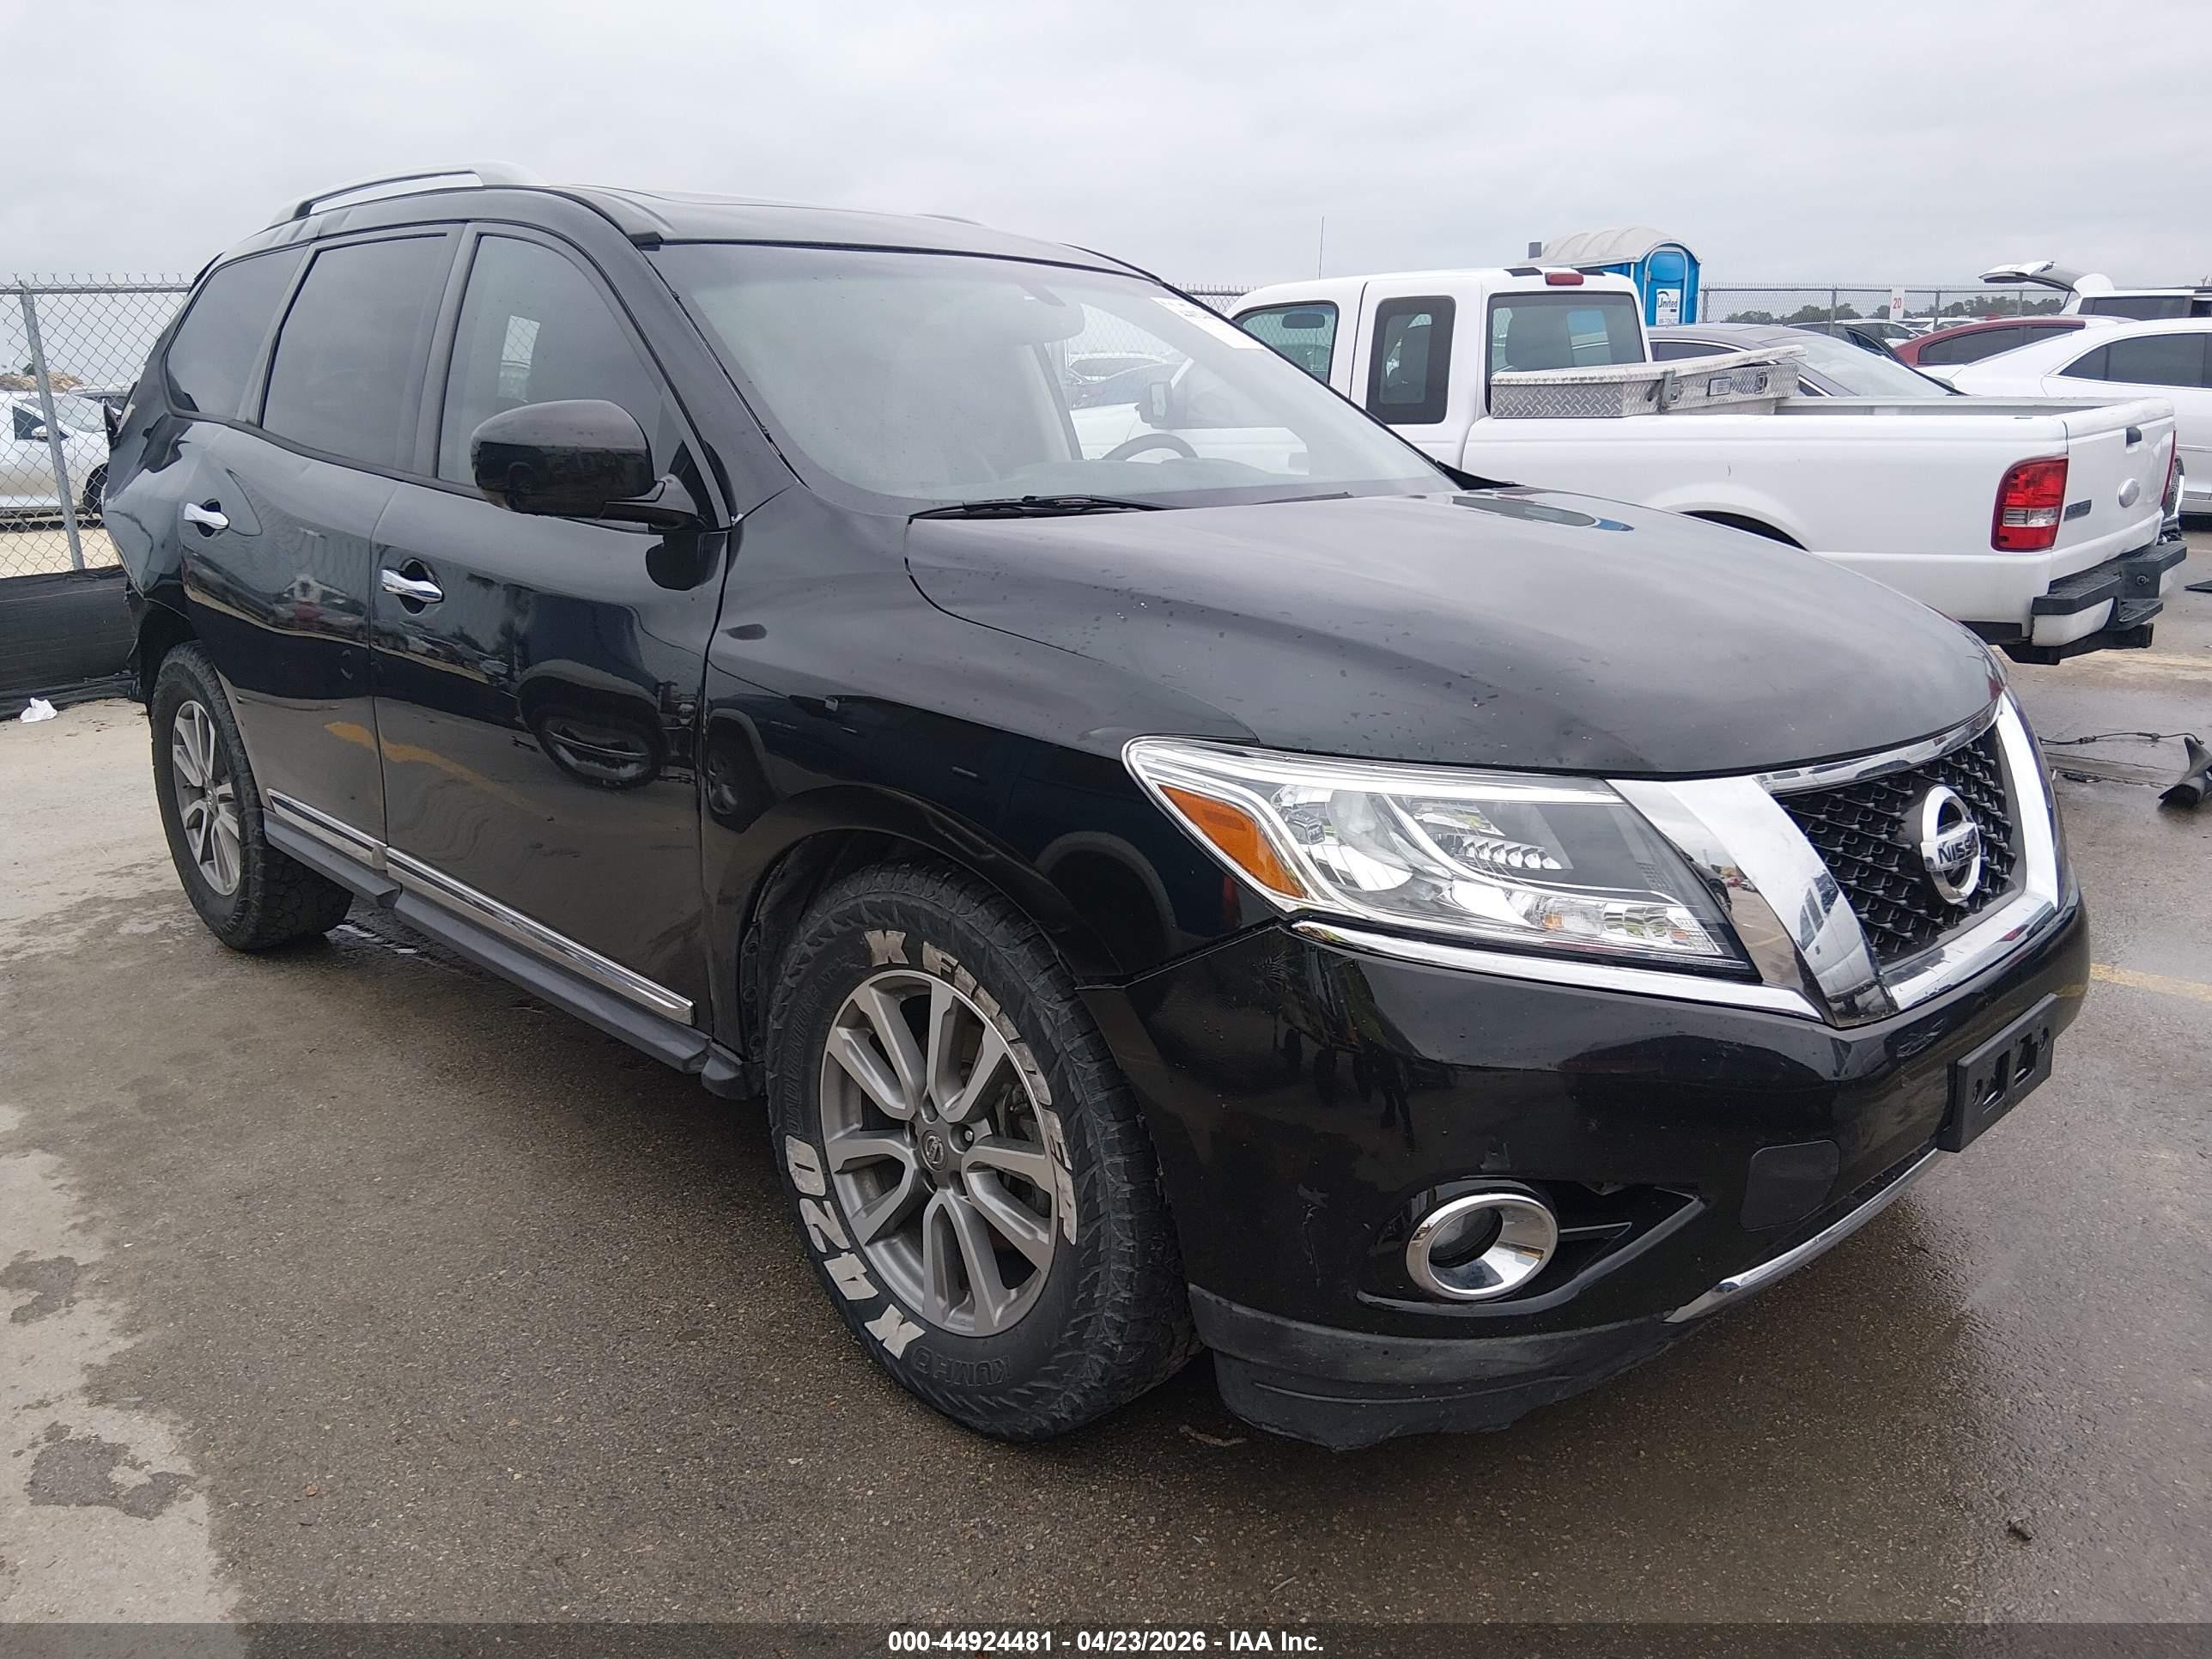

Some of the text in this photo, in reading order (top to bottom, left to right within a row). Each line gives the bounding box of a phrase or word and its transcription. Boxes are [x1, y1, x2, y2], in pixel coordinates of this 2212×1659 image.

[1657, 296, 1680, 308] United
[1893, 297, 1902, 309] 20
[1937, 835, 1977, 865] NISS
[911, 1346, 1012, 1389] KUMHO
